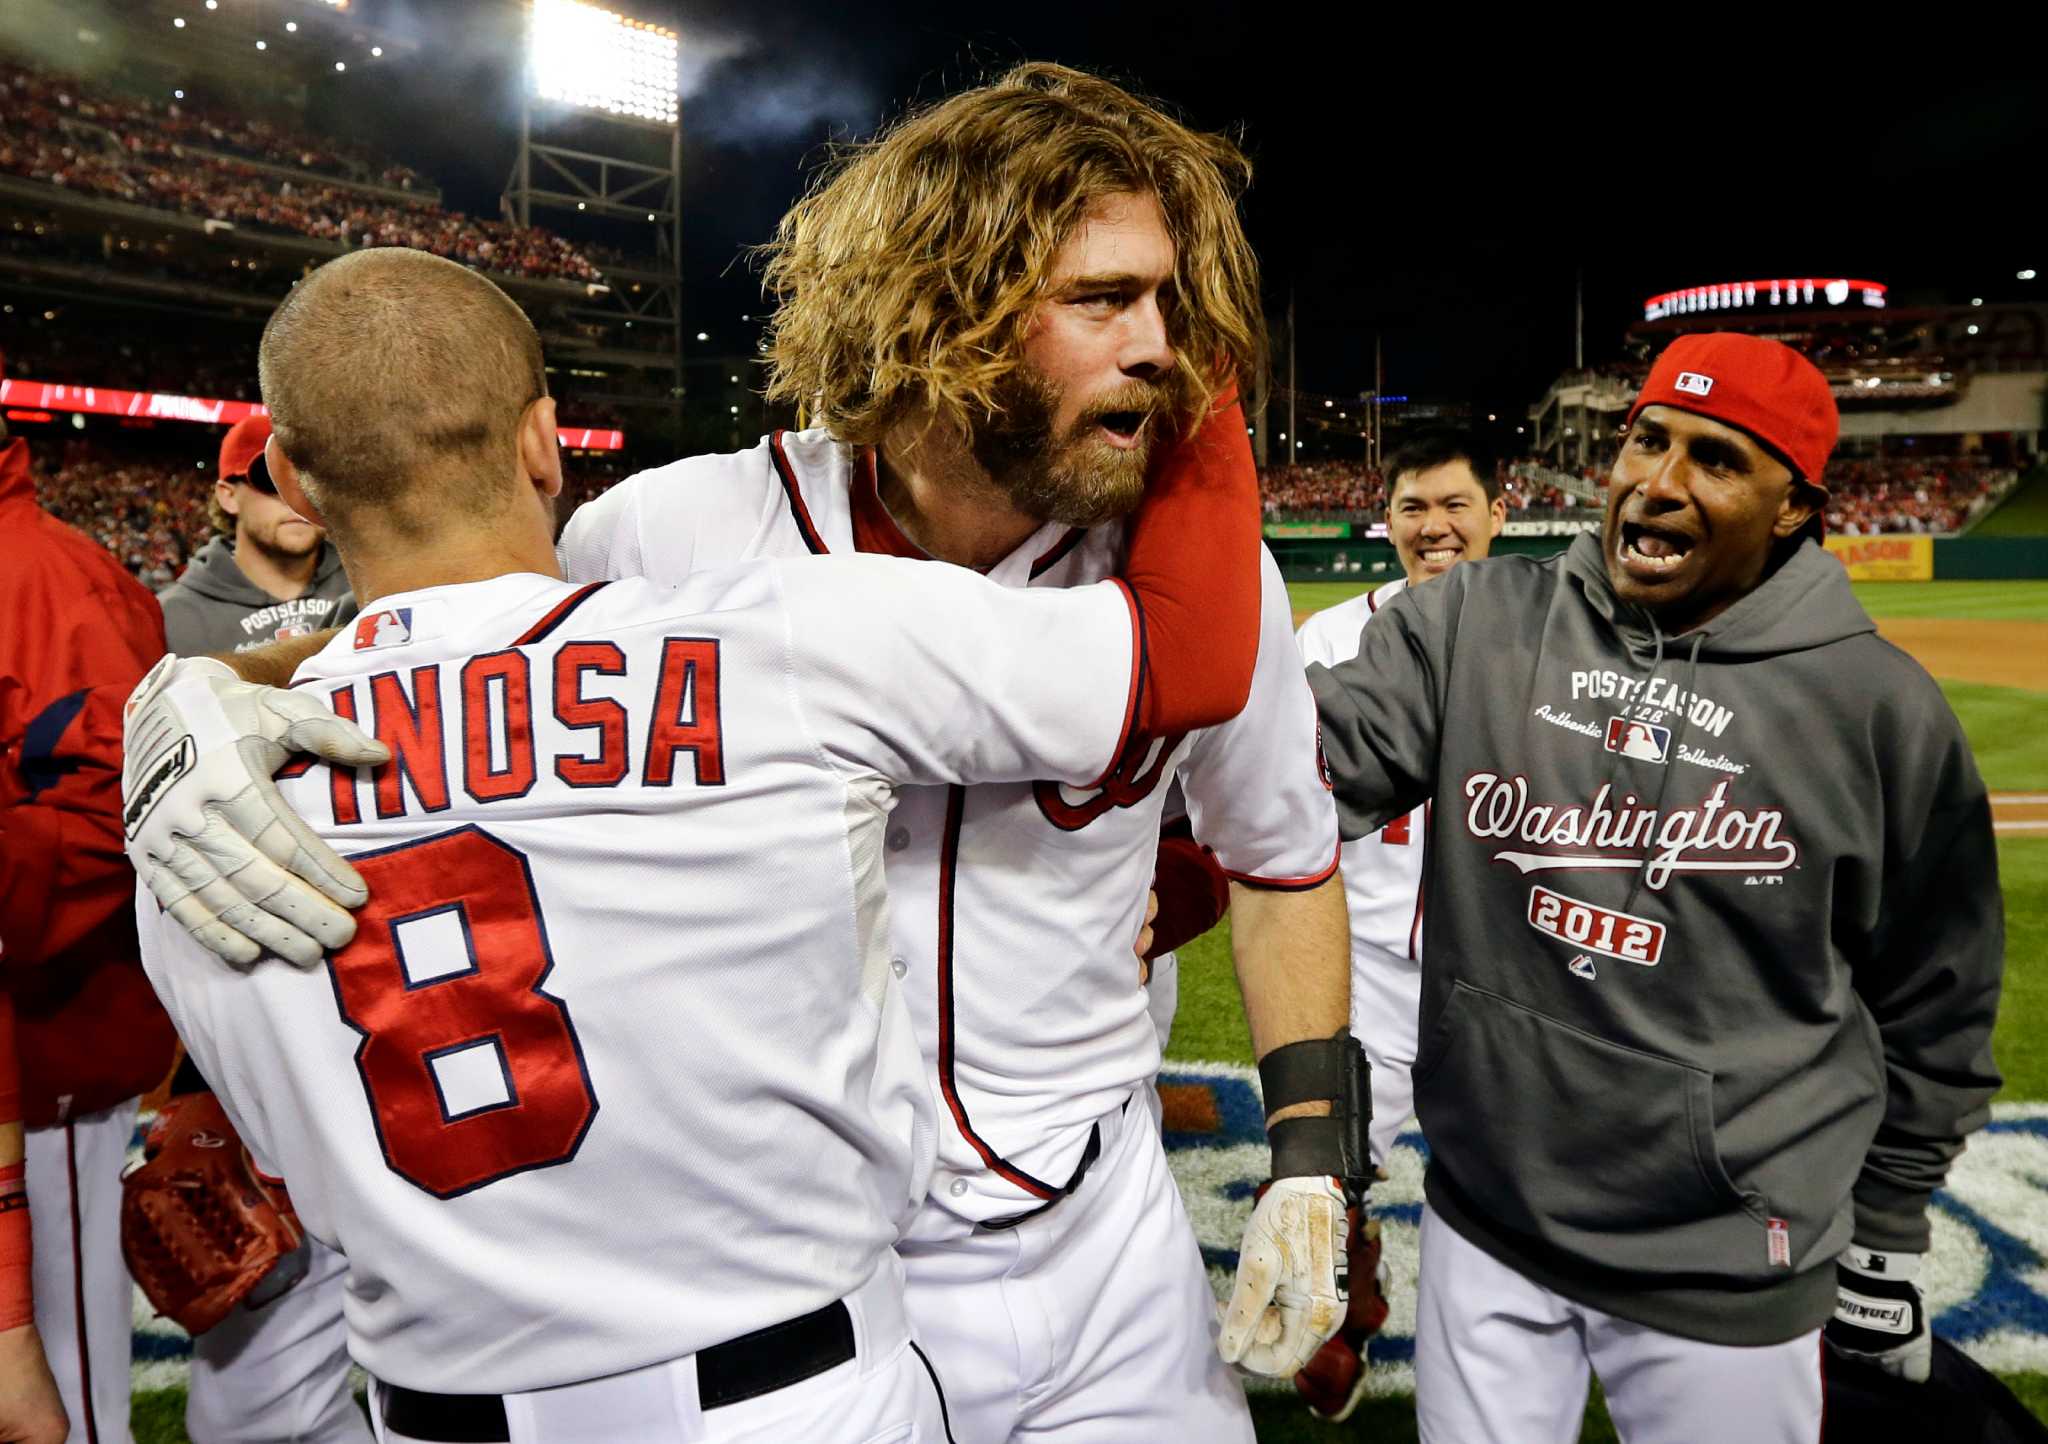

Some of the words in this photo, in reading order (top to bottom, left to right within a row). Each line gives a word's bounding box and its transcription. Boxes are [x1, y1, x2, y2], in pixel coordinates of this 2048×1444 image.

[275, 636, 727, 827] INOSA
[1534, 704, 1603, 738] Authentic
[1465, 772, 1798, 890] Washington
[1535, 893, 1654, 961] 2012
[324, 822, 600, 1200] 8
